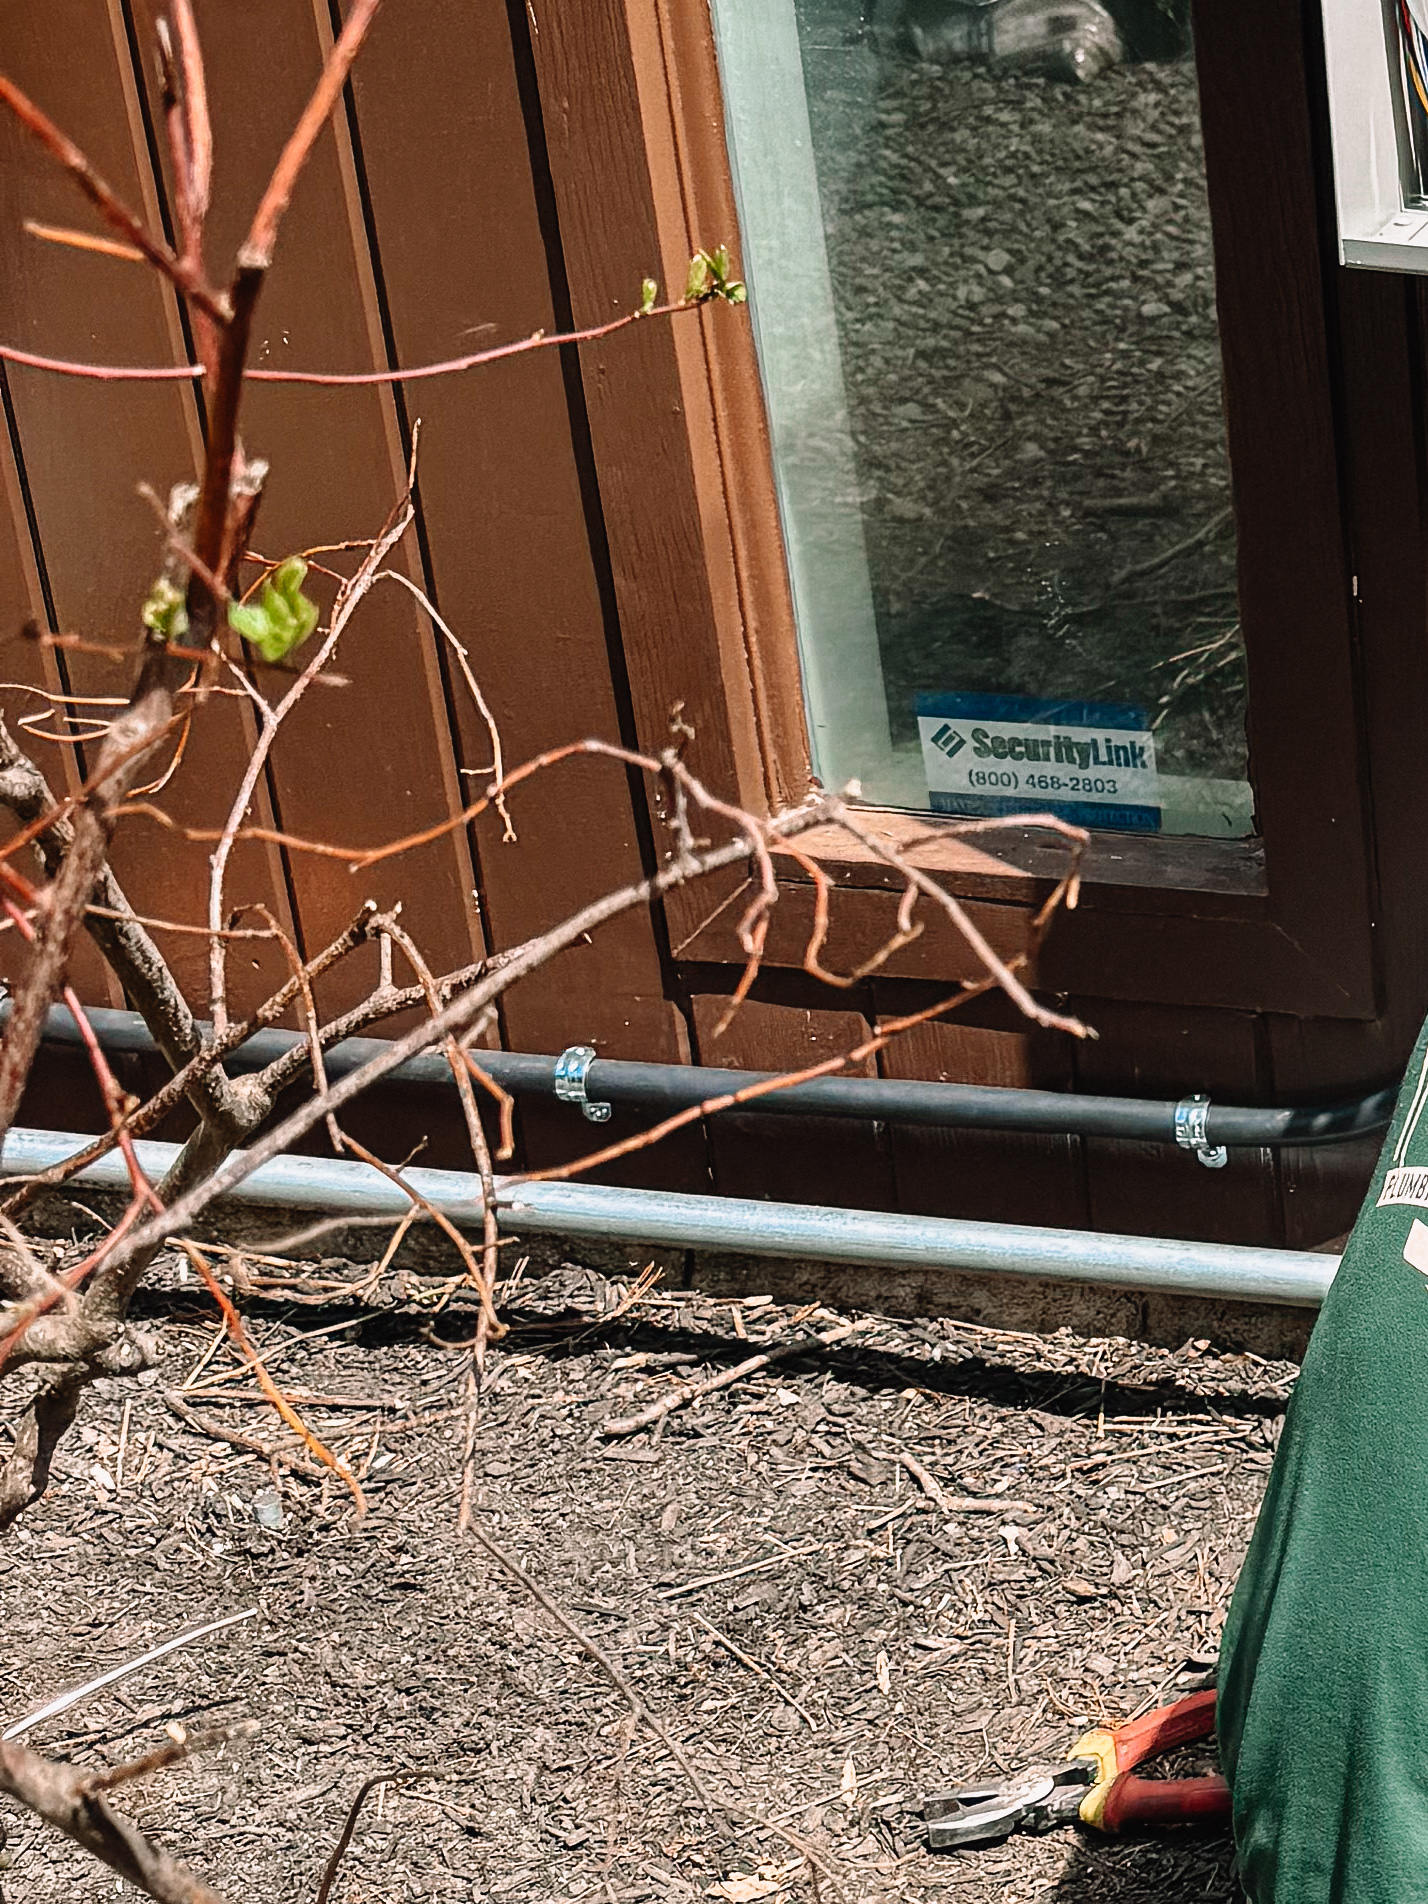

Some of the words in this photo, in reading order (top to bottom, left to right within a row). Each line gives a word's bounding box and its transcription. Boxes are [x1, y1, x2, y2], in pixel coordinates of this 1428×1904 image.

[971, 727, 1148, 770] SecurityLink
[968, 769, 1018, 790] (800)
[1025, 773, 1118, 794] 468-2803
